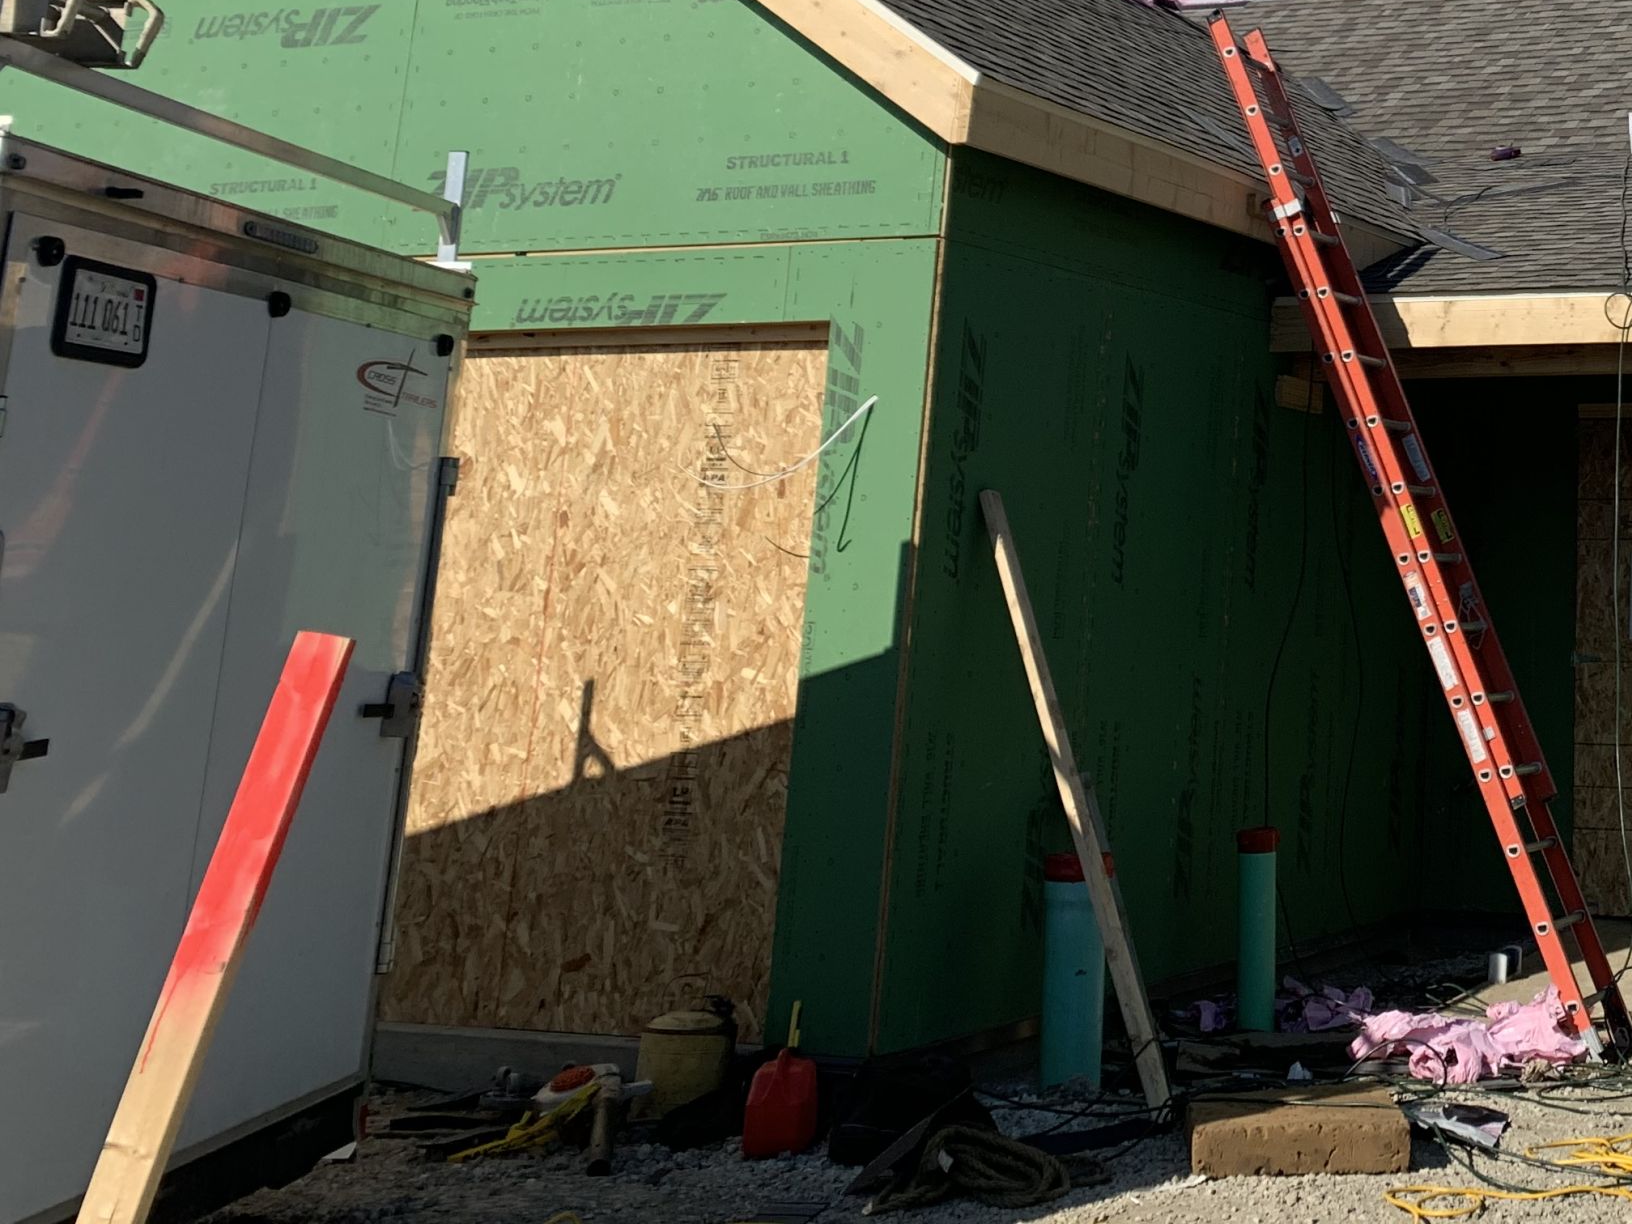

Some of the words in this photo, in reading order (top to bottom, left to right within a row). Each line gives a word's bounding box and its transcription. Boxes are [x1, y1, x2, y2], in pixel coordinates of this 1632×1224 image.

[726, 151, 837, 170] STRUCTURAL
[209, 179, 309, 196] STRUCTURAL
[811, 180, 876, 197] SHEATHING
[69, 293, 99, 329] 111
